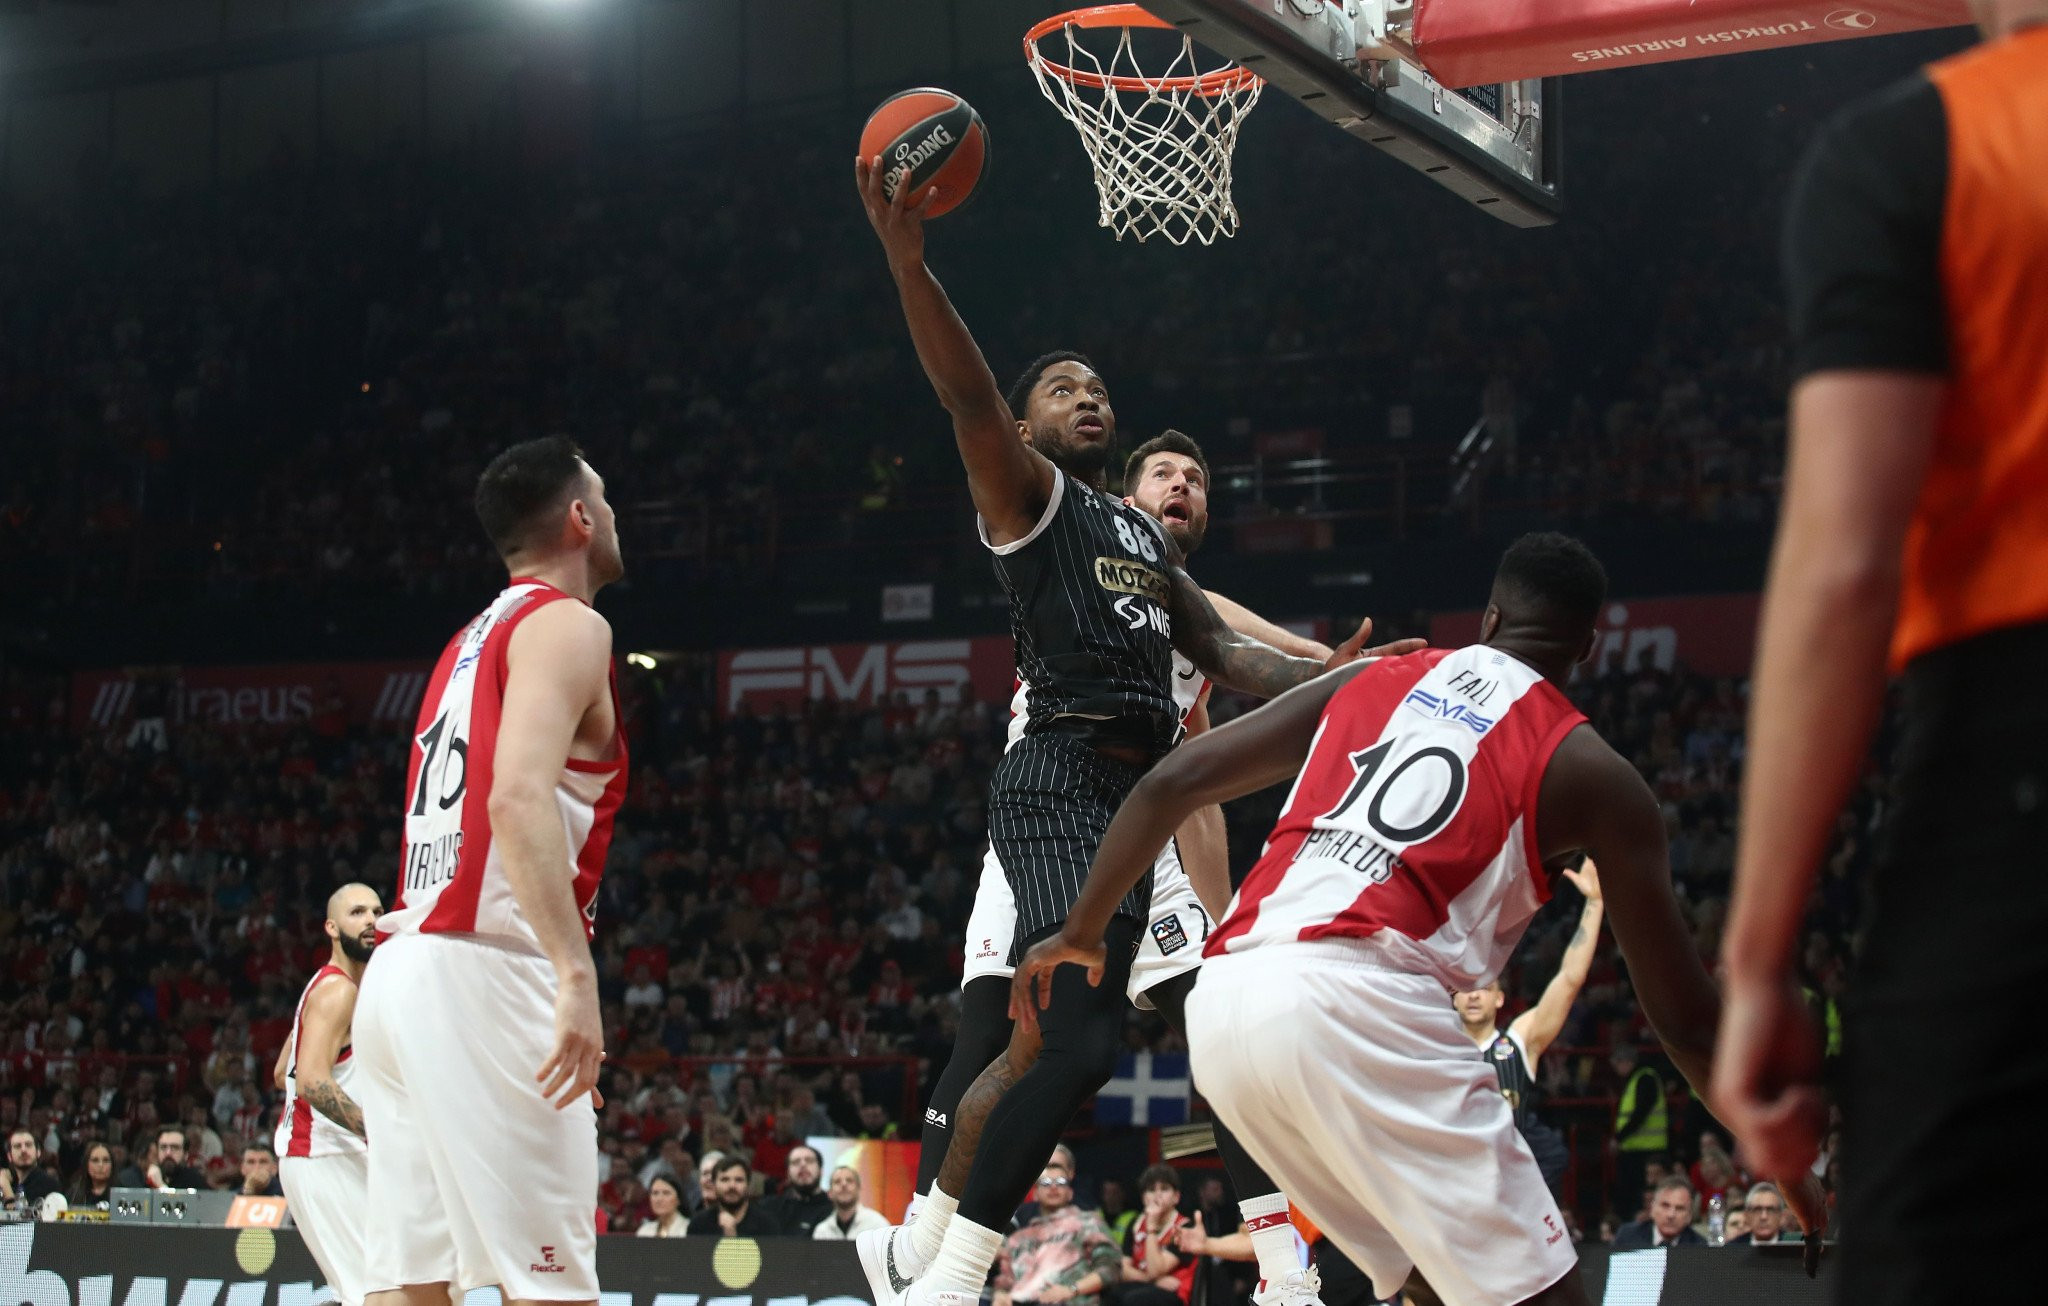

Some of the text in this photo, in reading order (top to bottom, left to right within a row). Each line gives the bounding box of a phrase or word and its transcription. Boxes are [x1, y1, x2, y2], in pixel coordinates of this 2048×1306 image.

[1571, 20, 1816, 62] TURKISH AIRLINES
[1113, 515, 1158, 563] 88
[729, 640, 971, 712] FMS
[1447, 669, 1499, 707] FALL
[1406, 689, 1494, 733] FMS
[412, 711, 468, 816] 16
[1322, 737, 1465, 843] 10
[925, 1106, 947, 1126] SA
[530, 1263, 566, 1272] FlexCar
